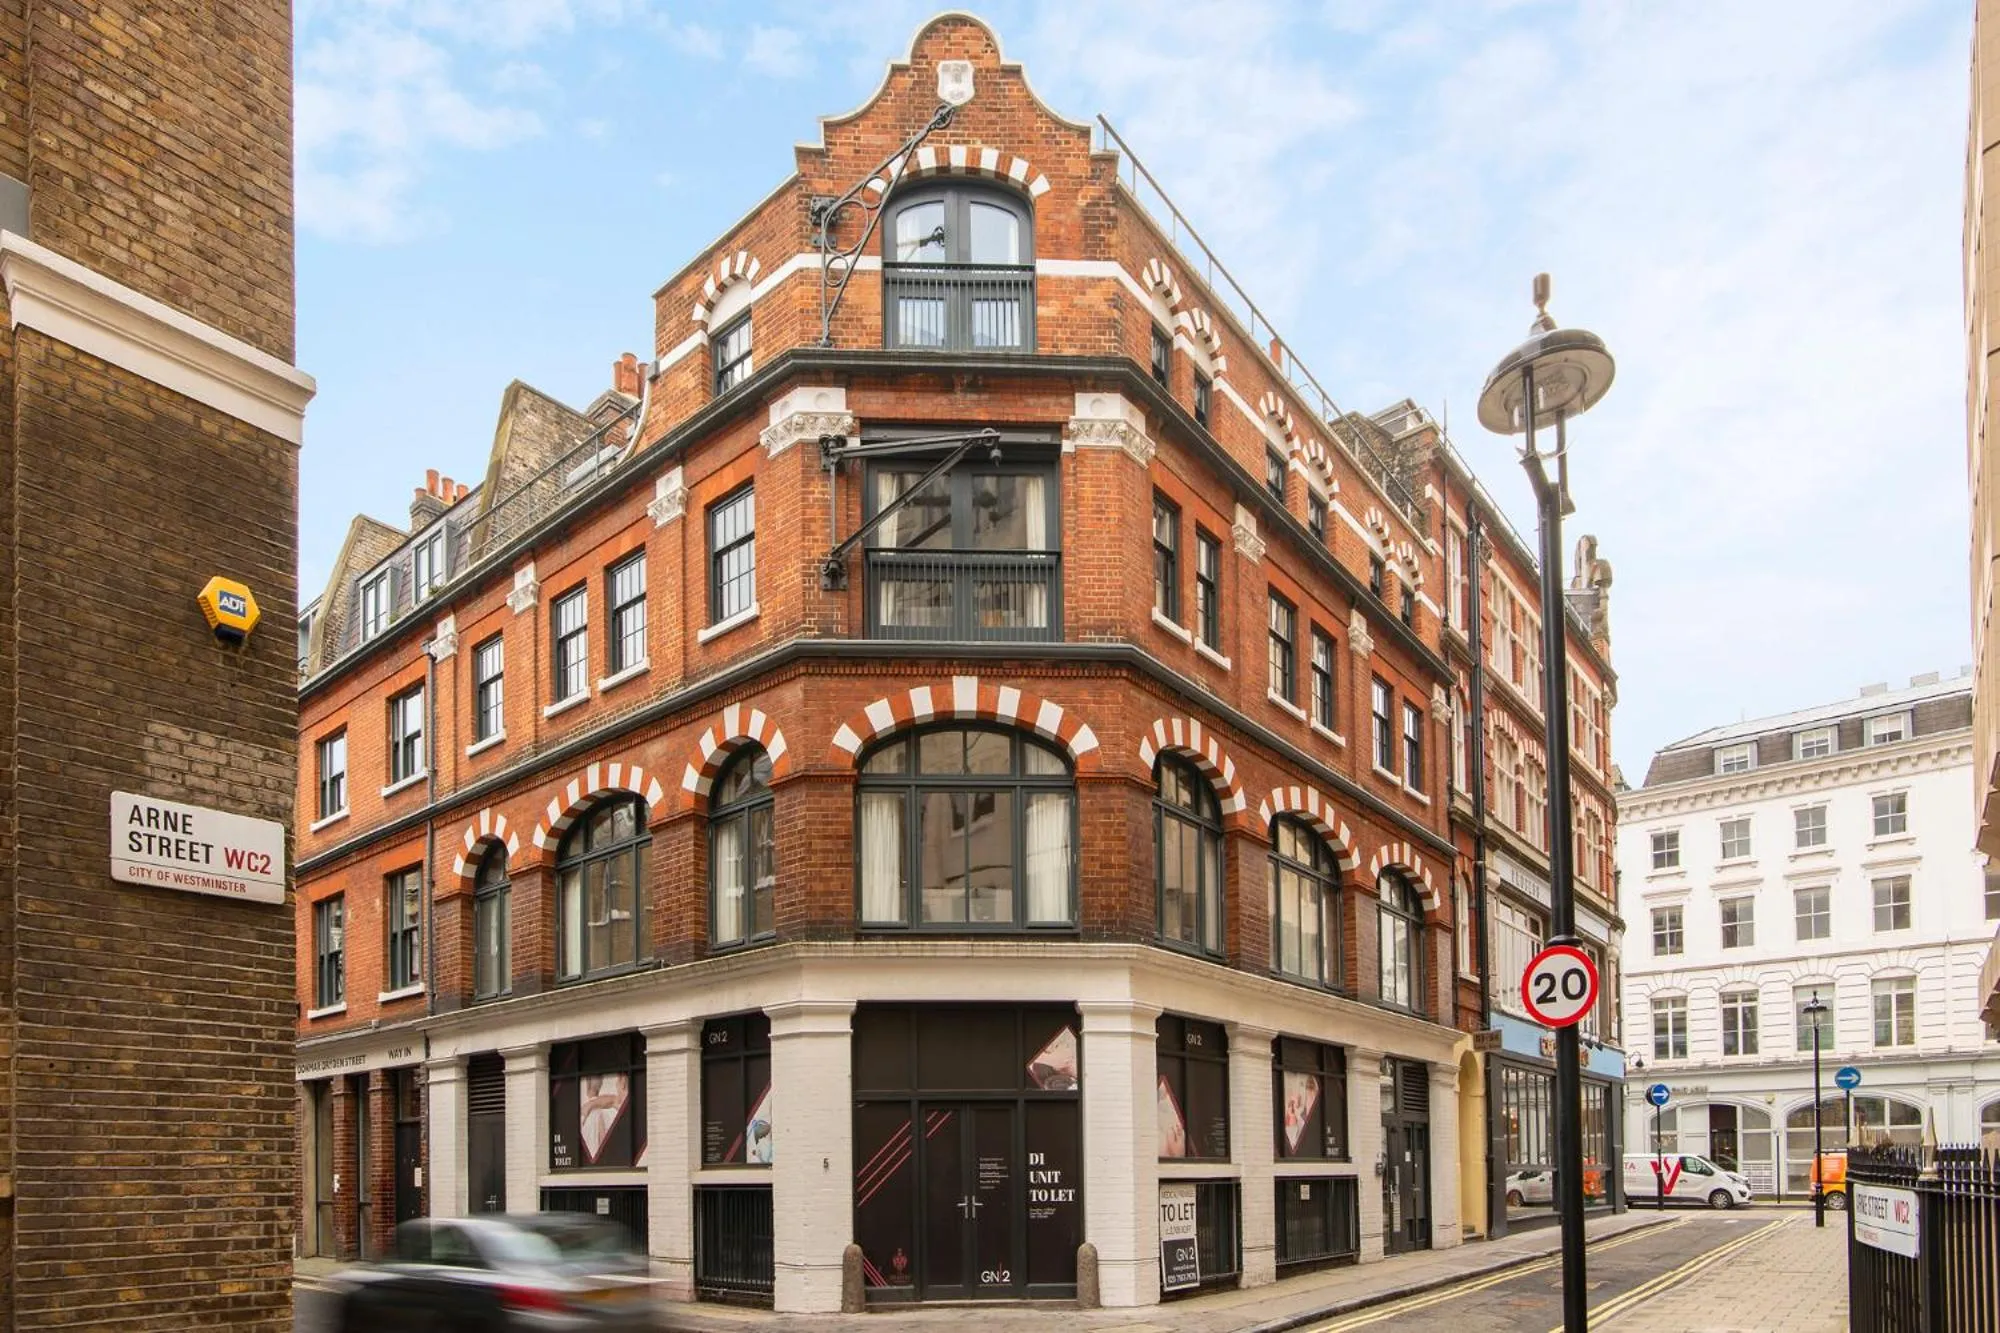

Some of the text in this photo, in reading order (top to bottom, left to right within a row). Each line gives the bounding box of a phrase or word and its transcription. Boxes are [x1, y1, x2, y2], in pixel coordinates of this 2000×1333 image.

[219, 596, 245, 612] ADT
[128, 804, 194, 835] ARNE
[128, 831, 272, 875] STREET WC2
[129, 866, 247, 893] CITY OF WESTMINSTER
[1534, 967, 1587, 1004] 20
[345, 1054, 366, 1066] STREET
[388, 1046, 412, 1060] WAY IN
[1029, 1171, 1061, 1183] UNIT
[1030, 1189, 1075, 1202] TO LET
[1161, 1203, 1195, 1222] TO LET
[1868, 1195, 1888, 1220] STREET
[1894, 1200, 1910, 1224] WC2
